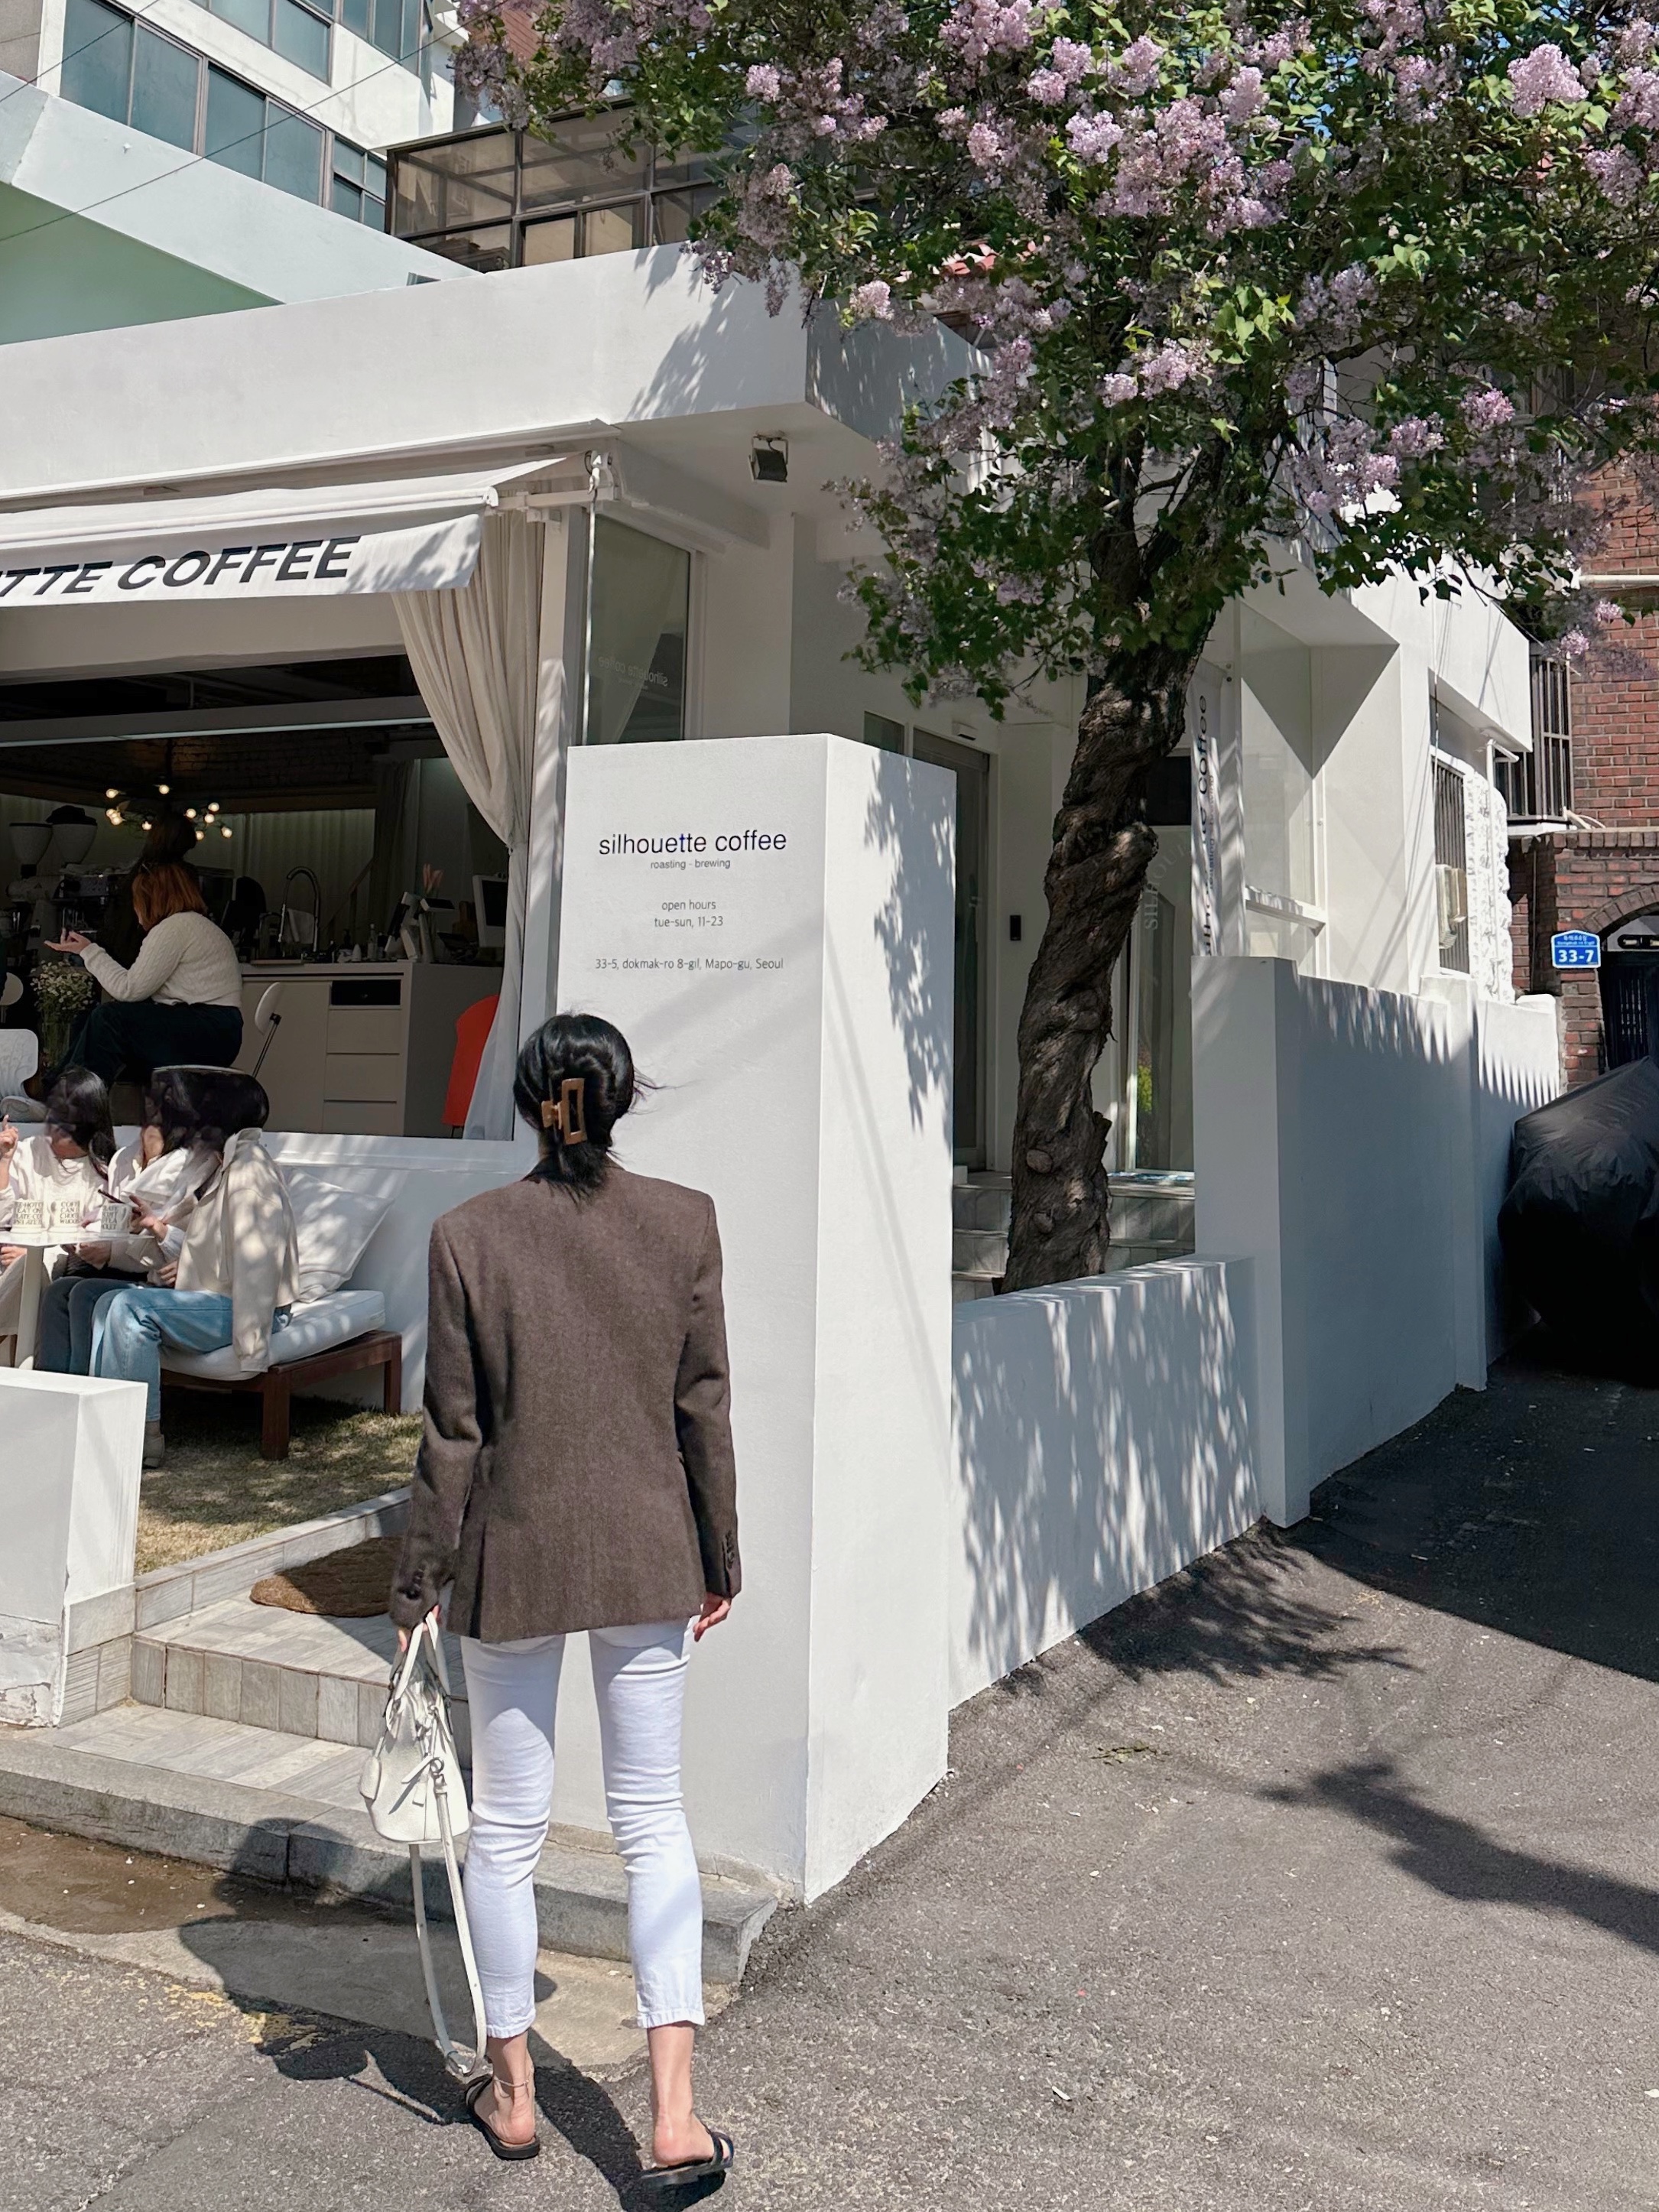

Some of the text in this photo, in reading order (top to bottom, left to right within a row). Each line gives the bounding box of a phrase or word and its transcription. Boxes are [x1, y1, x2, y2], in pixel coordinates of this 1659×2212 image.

[0, 536, 361, 597] TTE COFFEE
[1197, 695, 1207, 794] coffee
[599, 830, 787, 855] silhouette coffee
[650, 859, 687, 871] roasting
[694, 858, 731, 870] brewing
[661, 899, 716, 912] open hours
[654, 916, 724, 929] tue-sun, 11-23
[1558, 949, 1595, 963] 33-7
[595, 957, 784, 971] 33-5, dokmak-ro 8-gil, Mapo-gu, Seoul
